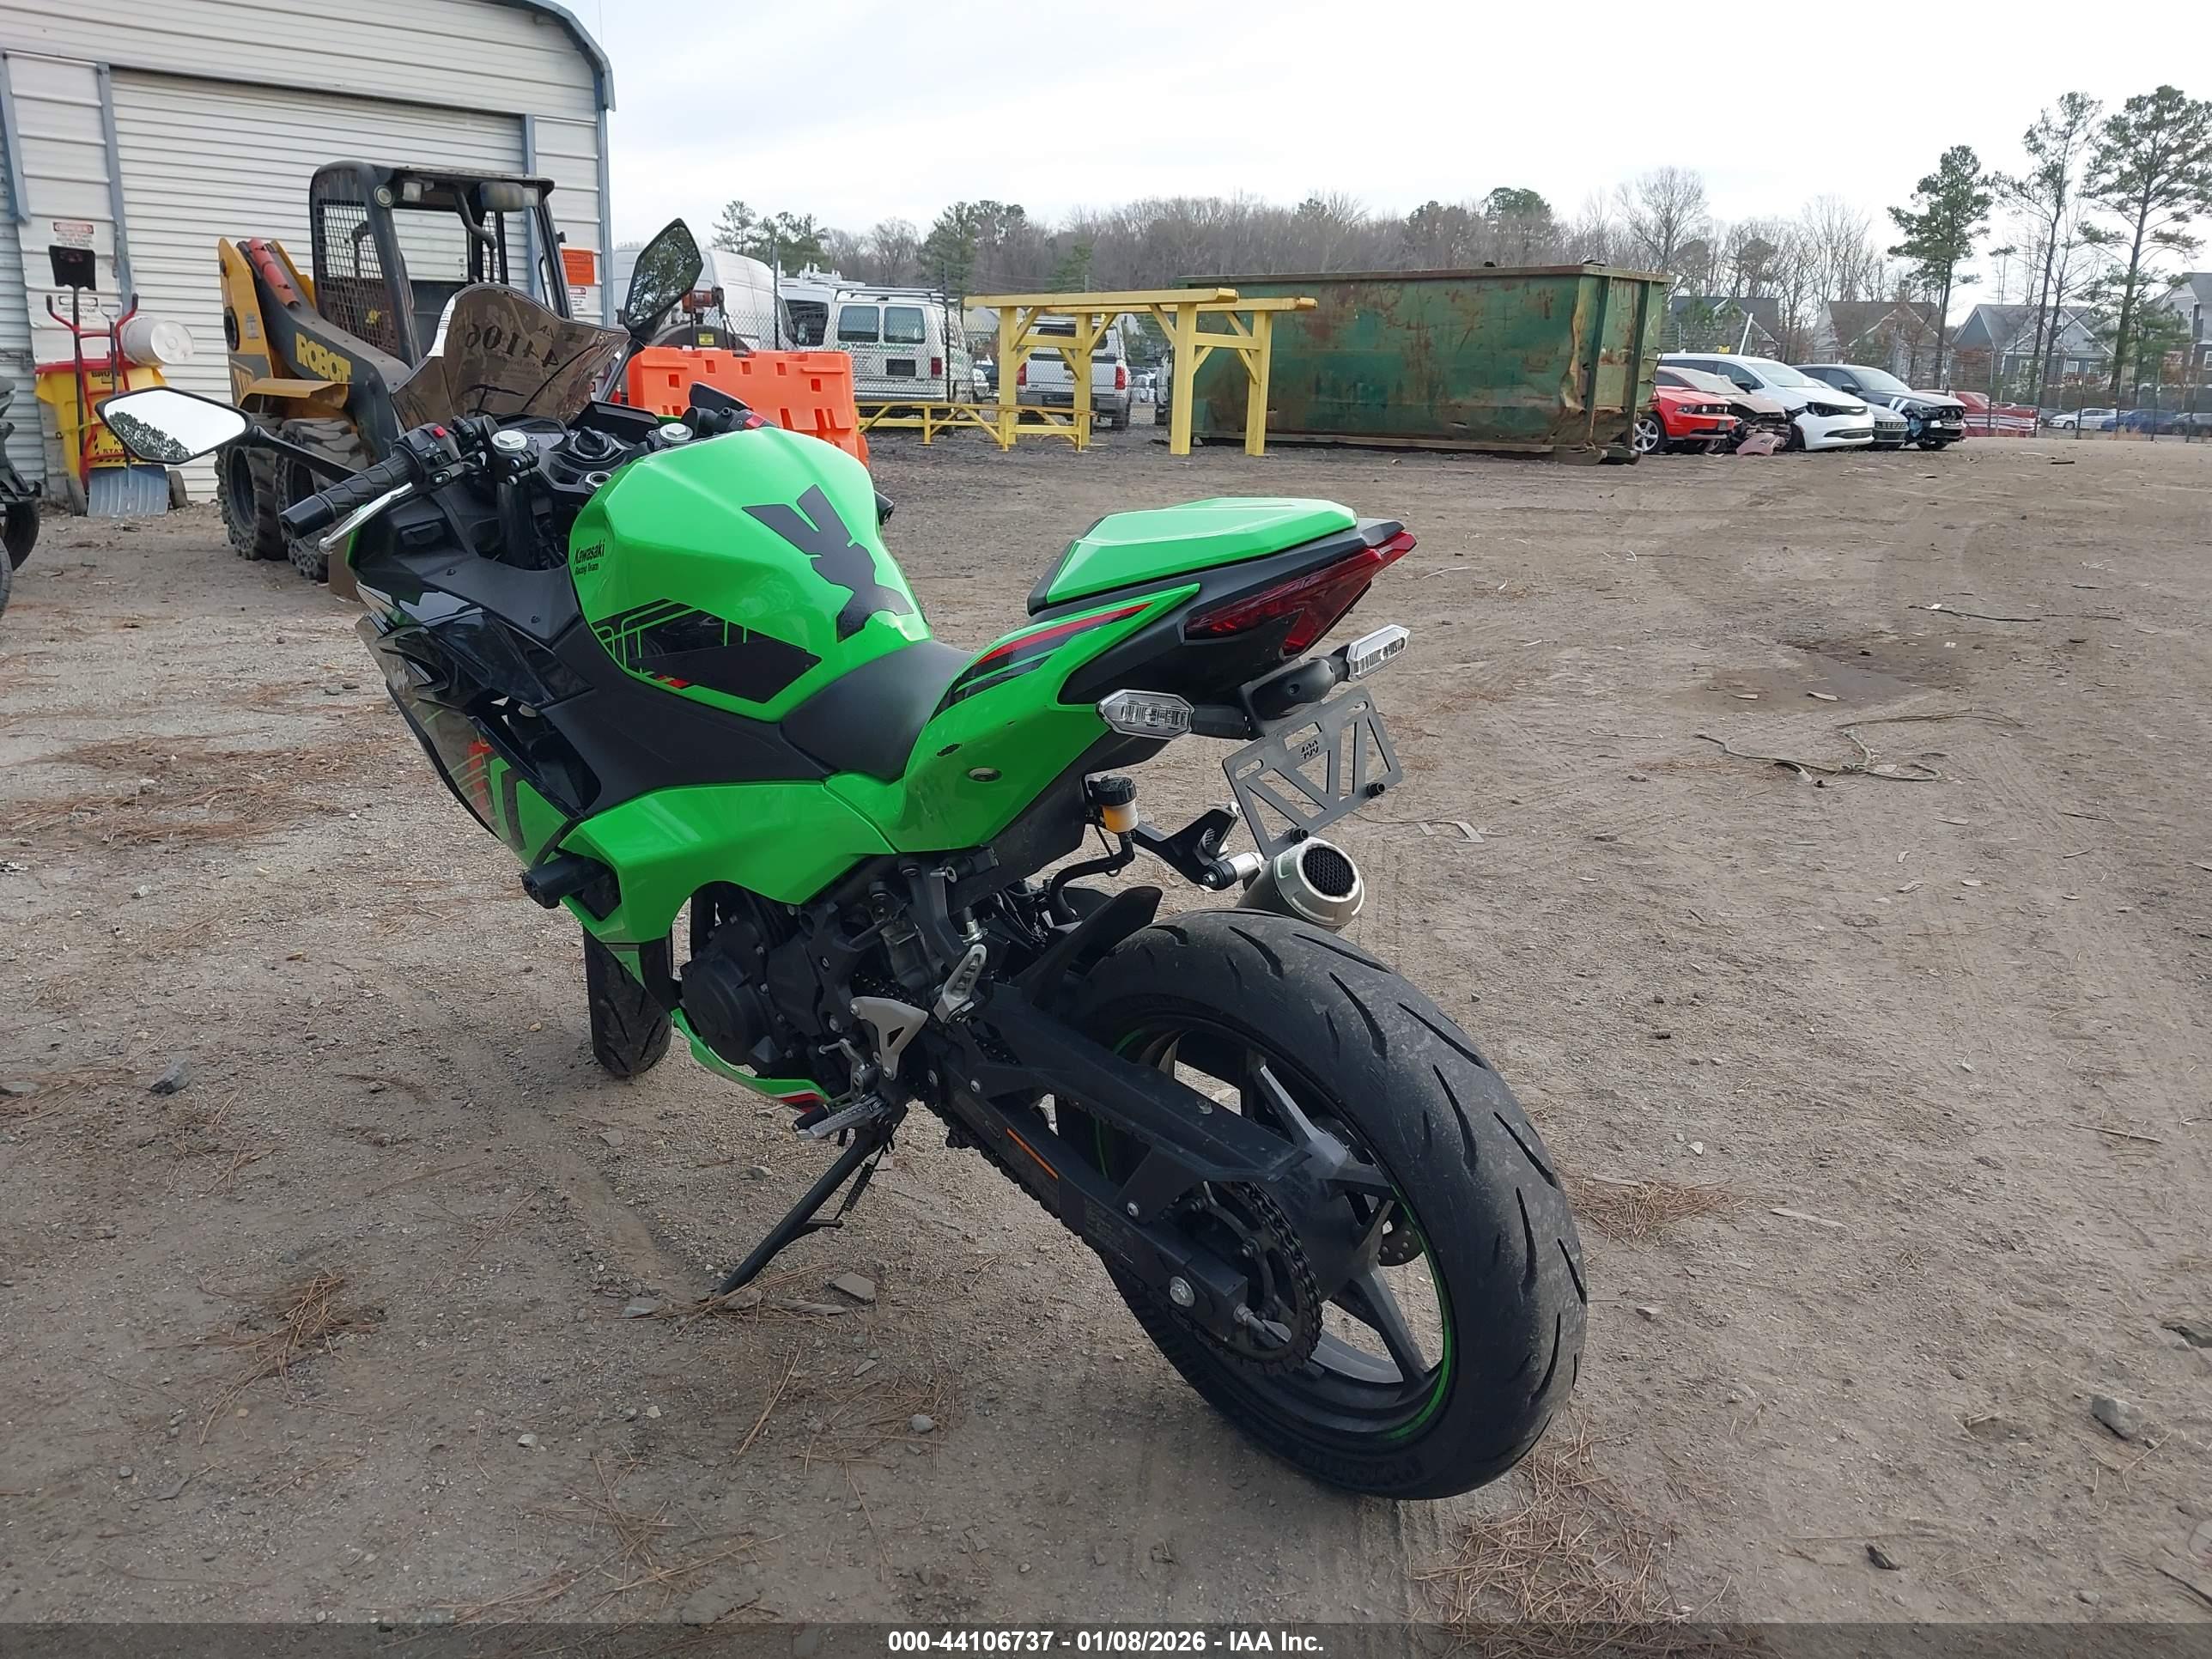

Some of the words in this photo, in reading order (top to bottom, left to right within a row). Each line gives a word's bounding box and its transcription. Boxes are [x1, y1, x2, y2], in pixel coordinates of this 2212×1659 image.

[296, 332, 351, 383] ROBOT
[574, 538, 605, 565] Kawasaki
[574, 565, 587, 575] Racing
[588, 562, 599, 572] Team
